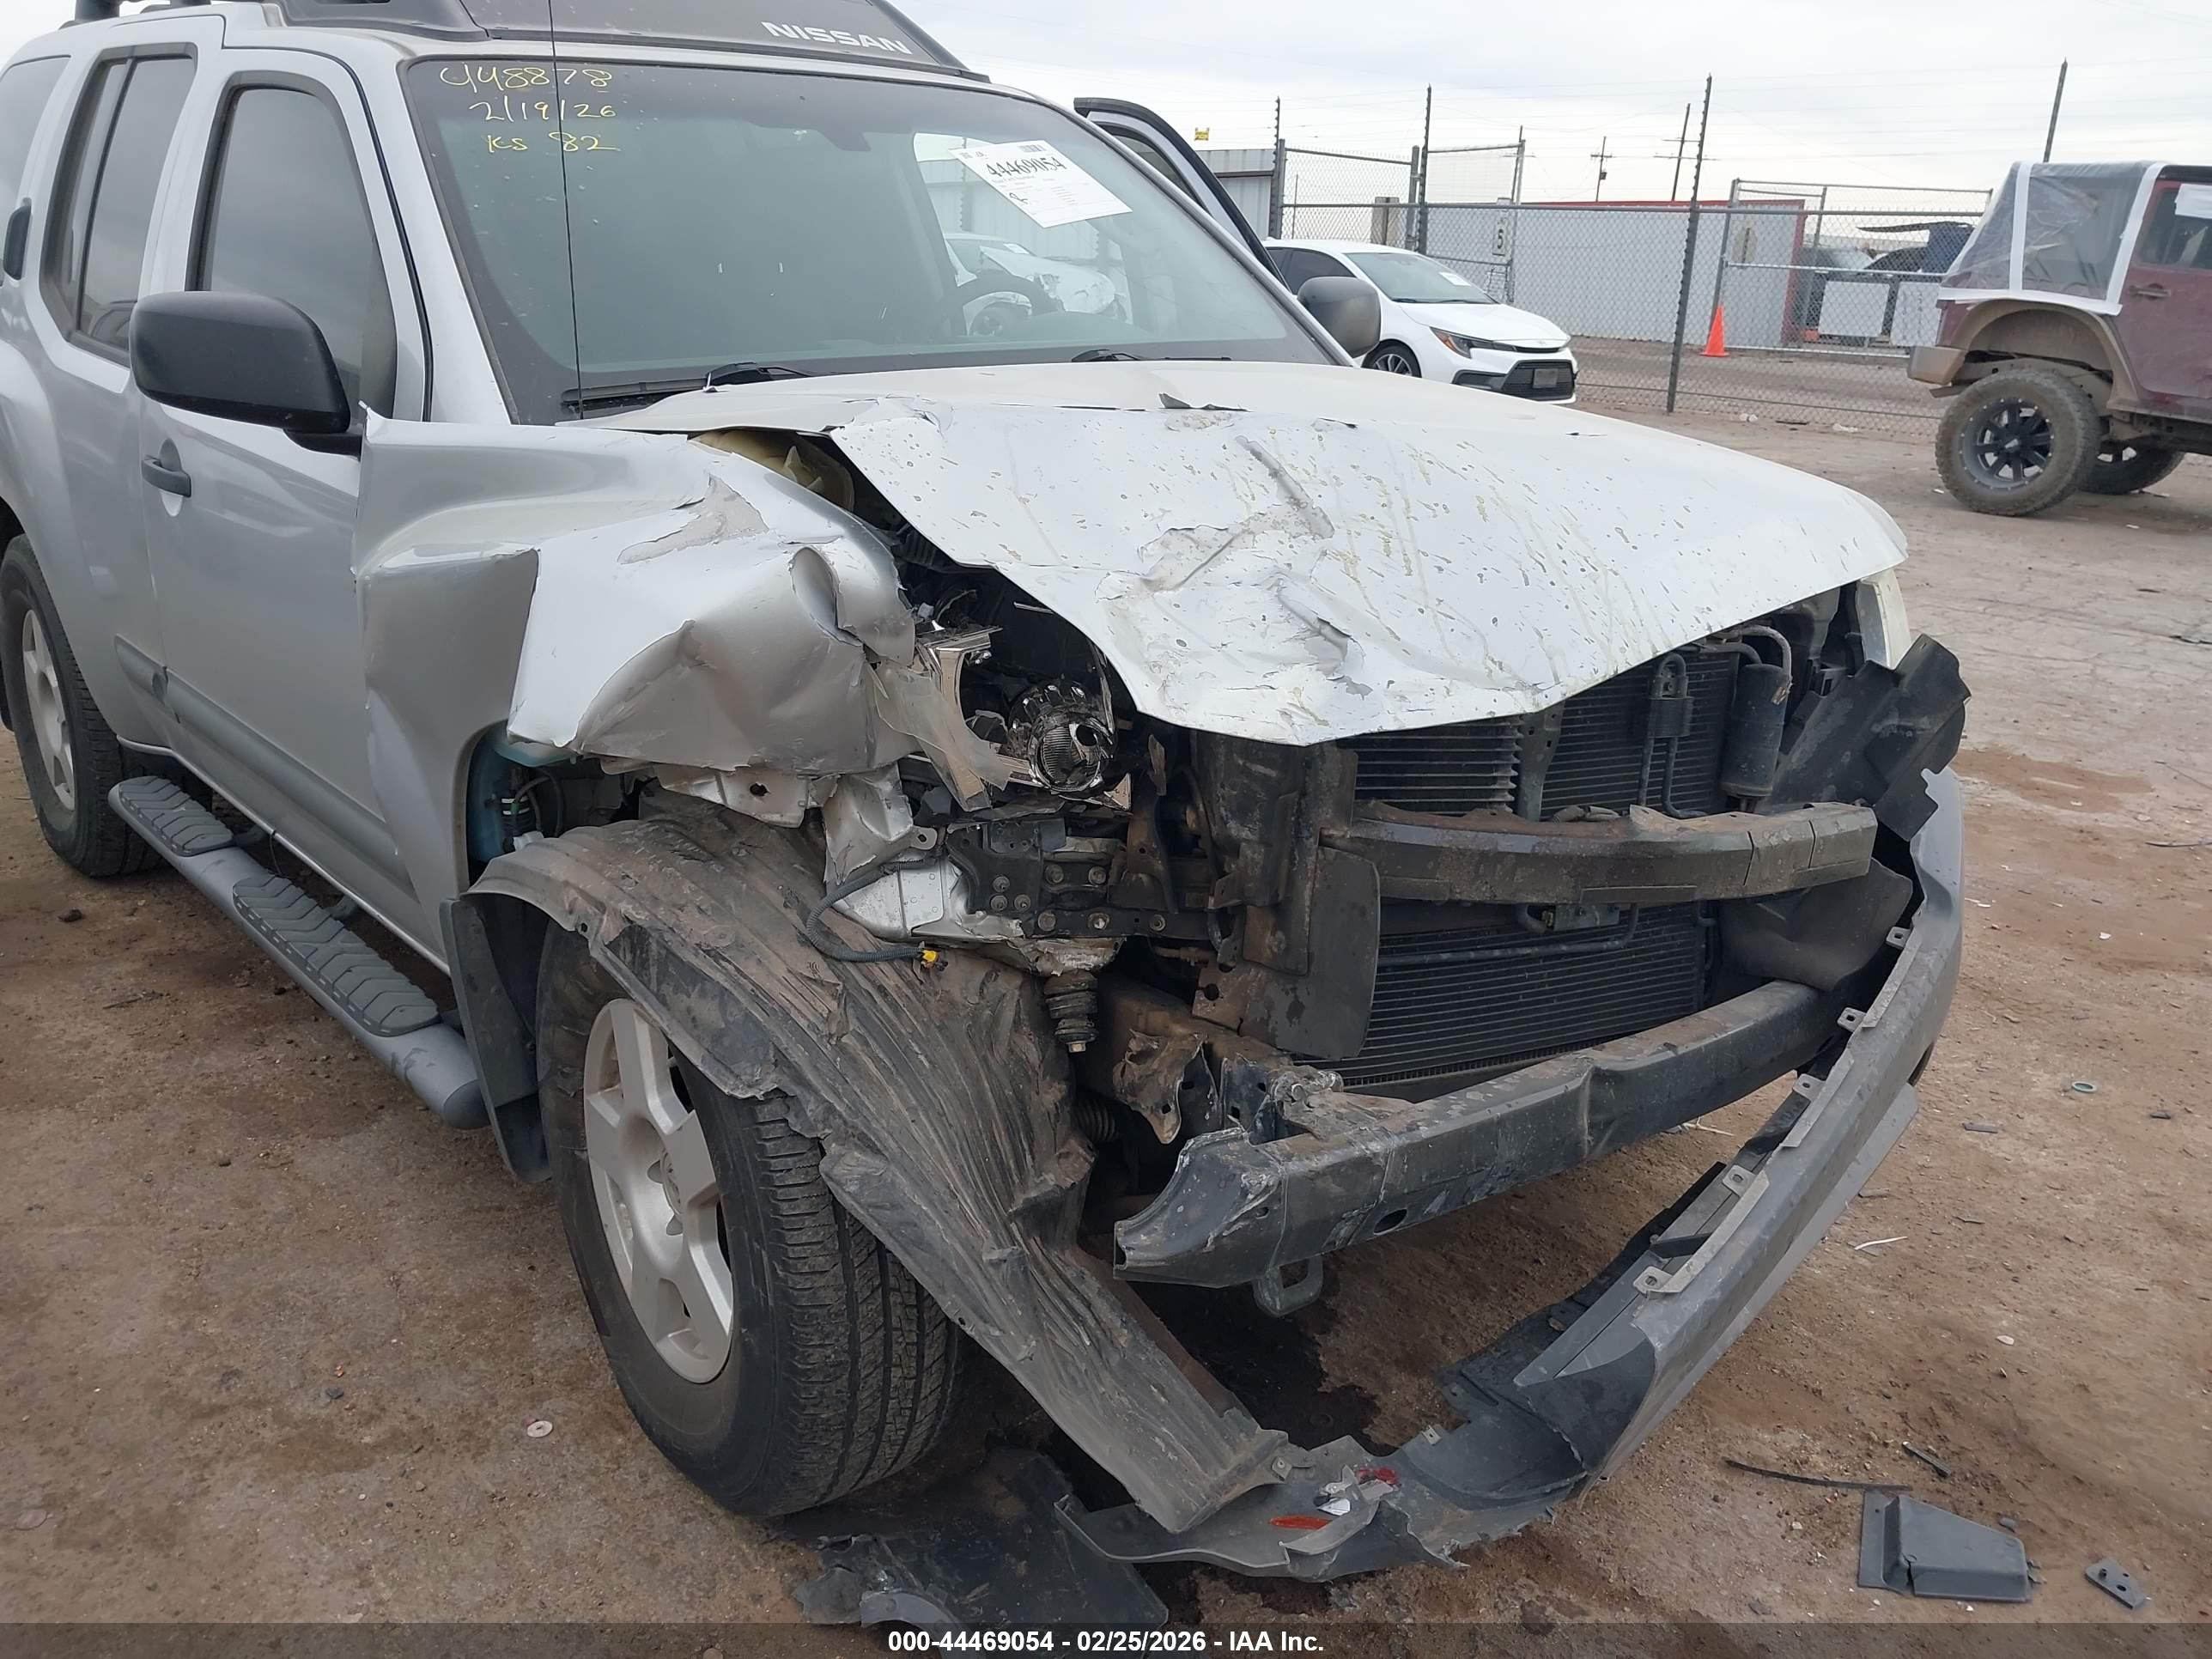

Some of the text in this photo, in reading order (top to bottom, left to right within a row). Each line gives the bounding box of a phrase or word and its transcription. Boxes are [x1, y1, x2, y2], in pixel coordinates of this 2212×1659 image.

[761, 21, 913, 55] NISSAN
[440, 64, 612, 93] 448878
[469, 95, 617, 122] 2/19/26
[548, 131, 621, 152] 82
[986, 156, 1067, 177] 44469054
[1498, 228, 1504, 249] 5
